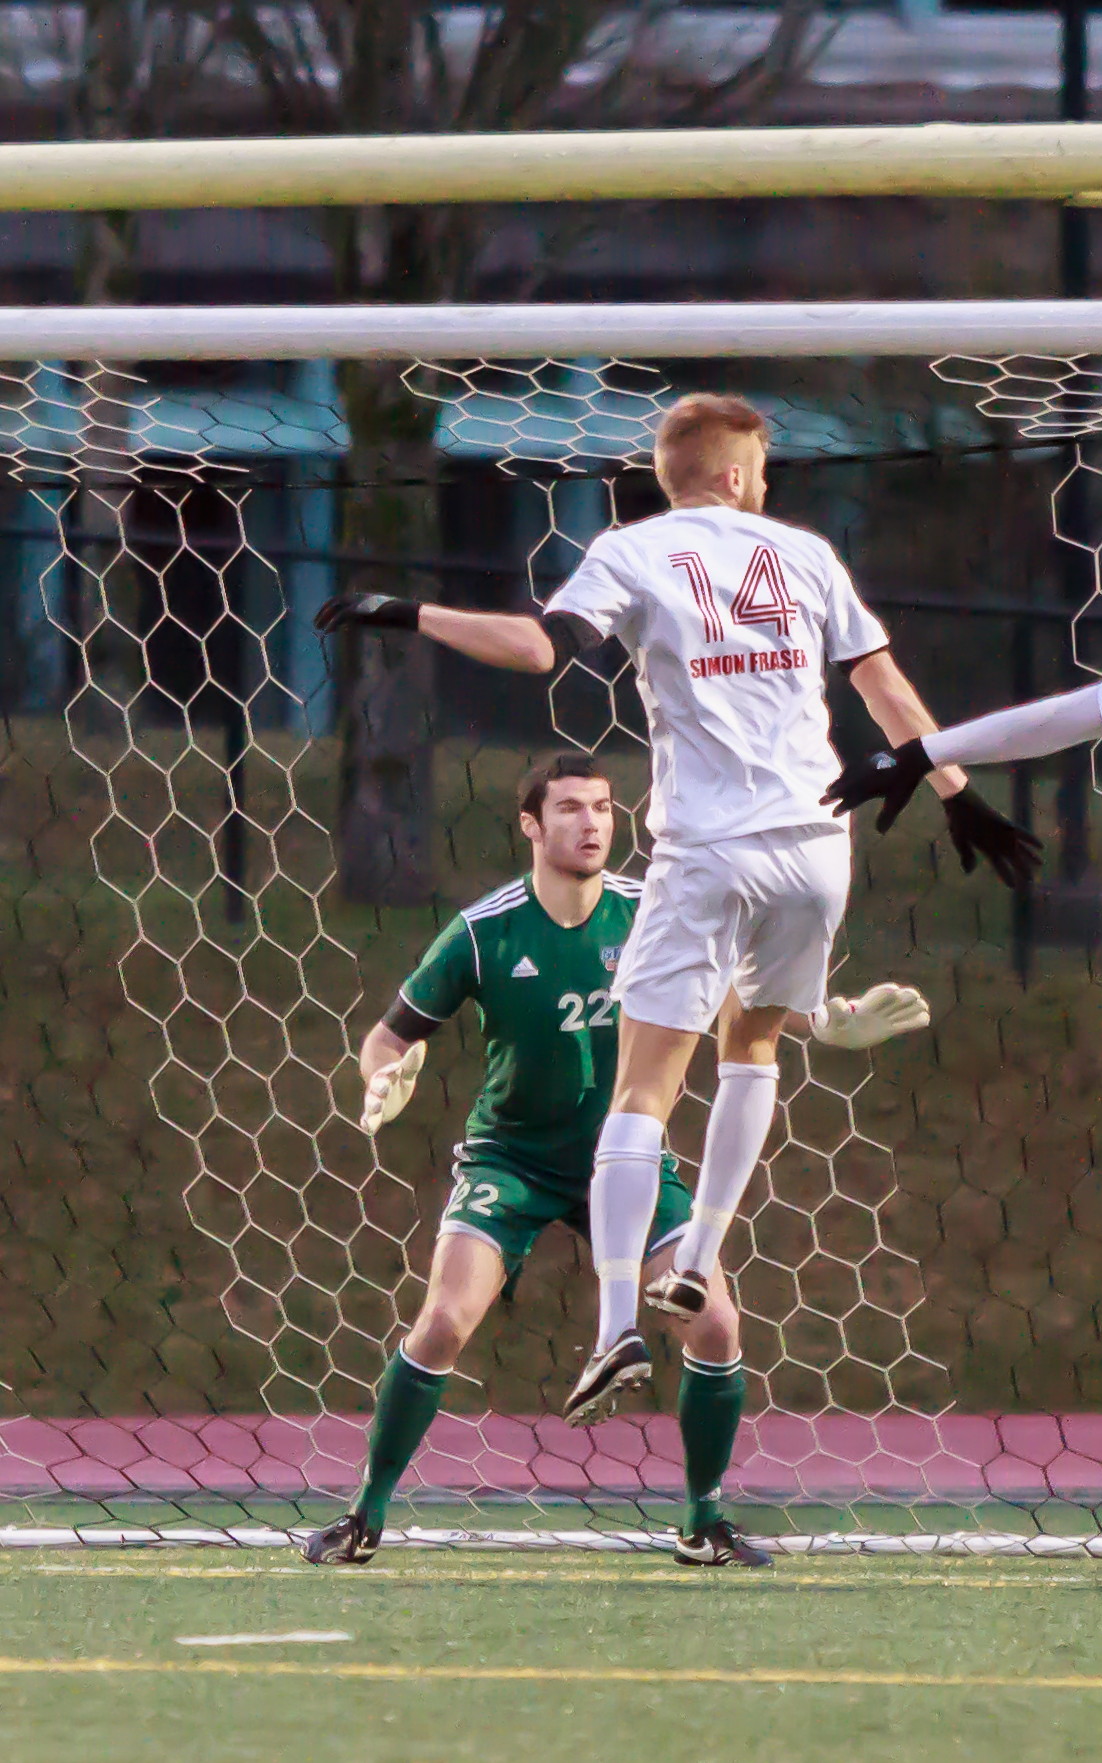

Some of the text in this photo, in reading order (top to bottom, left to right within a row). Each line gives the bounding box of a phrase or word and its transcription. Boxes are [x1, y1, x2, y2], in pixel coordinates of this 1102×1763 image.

[667, 544, 798, 644] 14
[689, 653, 745, 679] SIMON
[557, 989, 615, 1032] 22
[445, 1182, 500, 1217] 22
